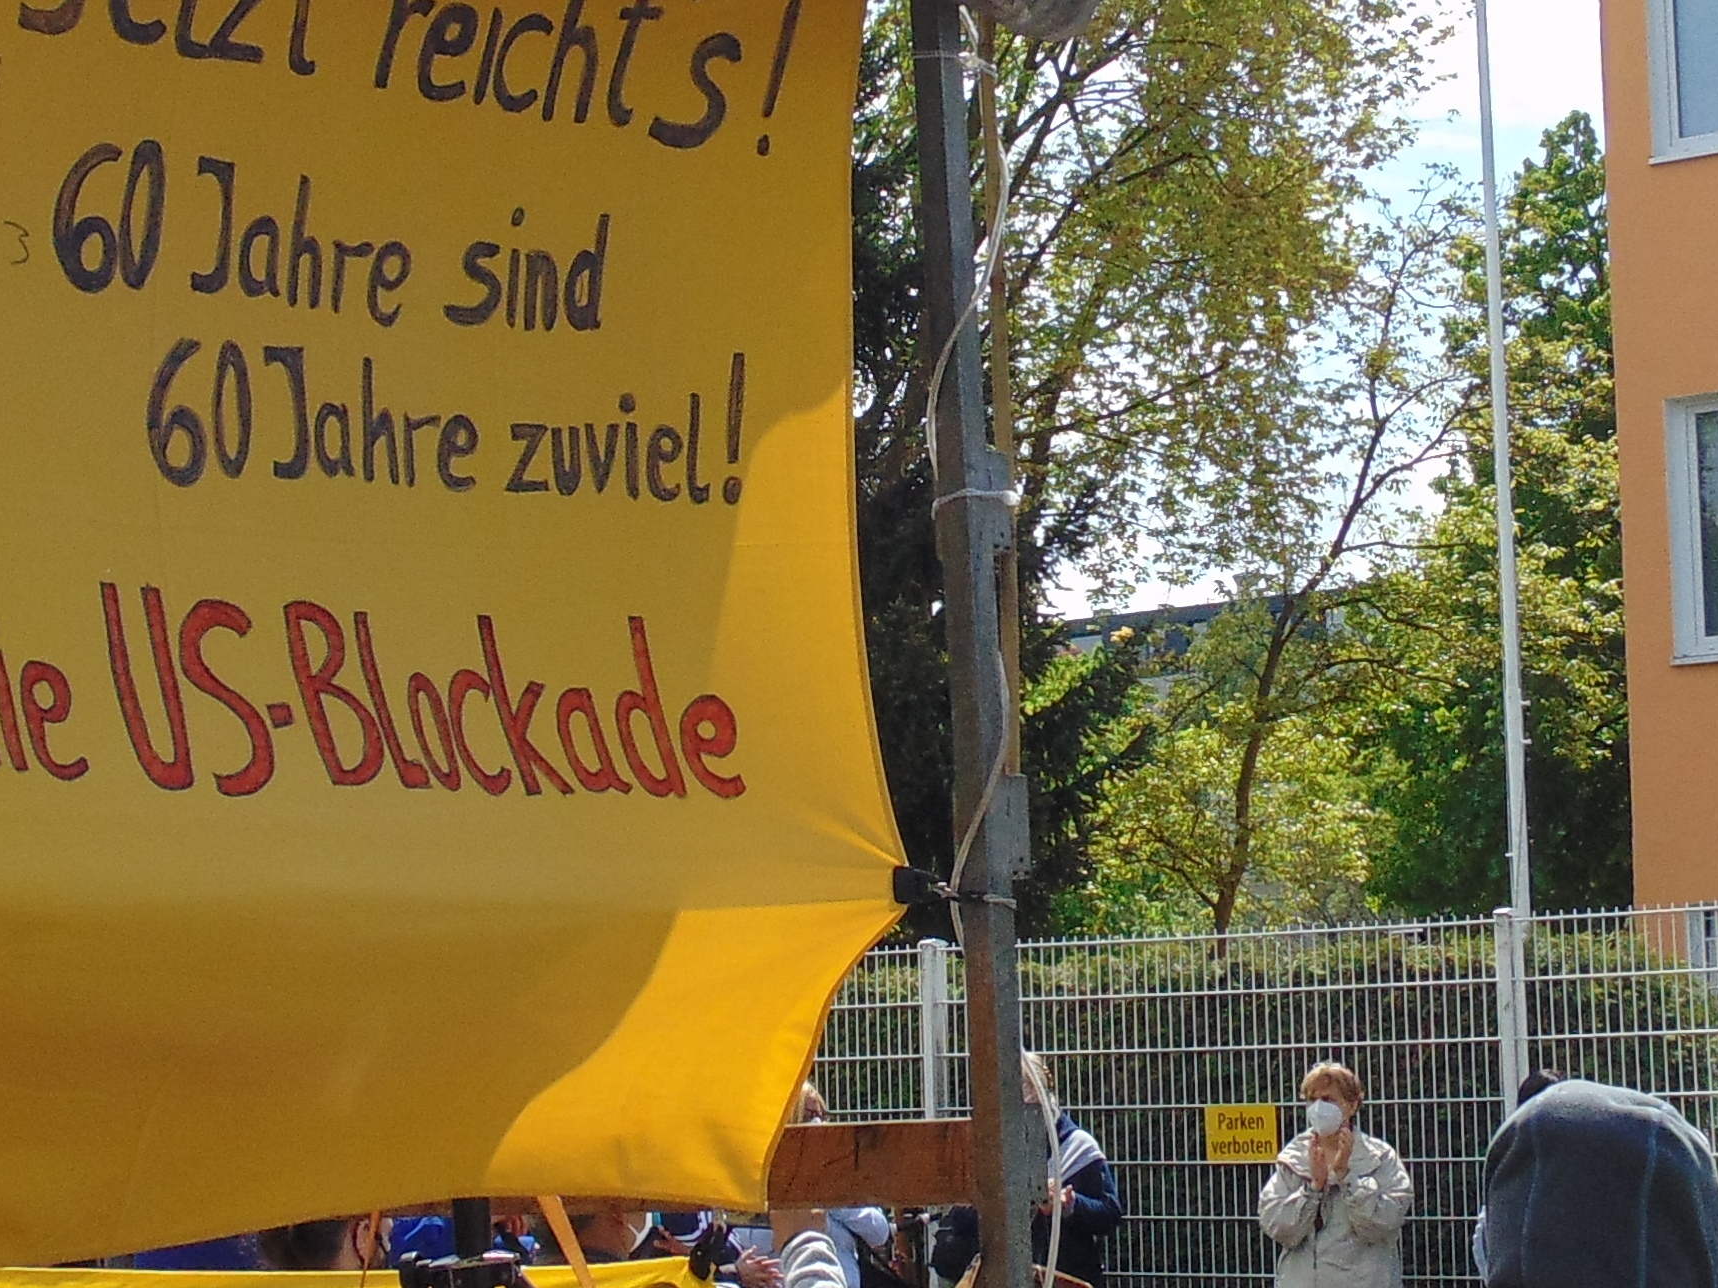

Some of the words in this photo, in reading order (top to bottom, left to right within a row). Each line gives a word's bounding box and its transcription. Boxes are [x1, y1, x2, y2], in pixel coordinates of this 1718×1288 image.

[53, 139, 166, 295] 60
[190, 155, 413, 329] Jahre
[443, 206, 611, 332] sind
[147, 338, 253, 488] 60
[263, 345, 480, 492] Jahre
[505, 353, 746, 507] zuviel!
[100, 579, 746, 798] US-Blockade
[1211, 1135, 1273, 1155] verboten
[1218, 1111, 1265, 1130] Parken
